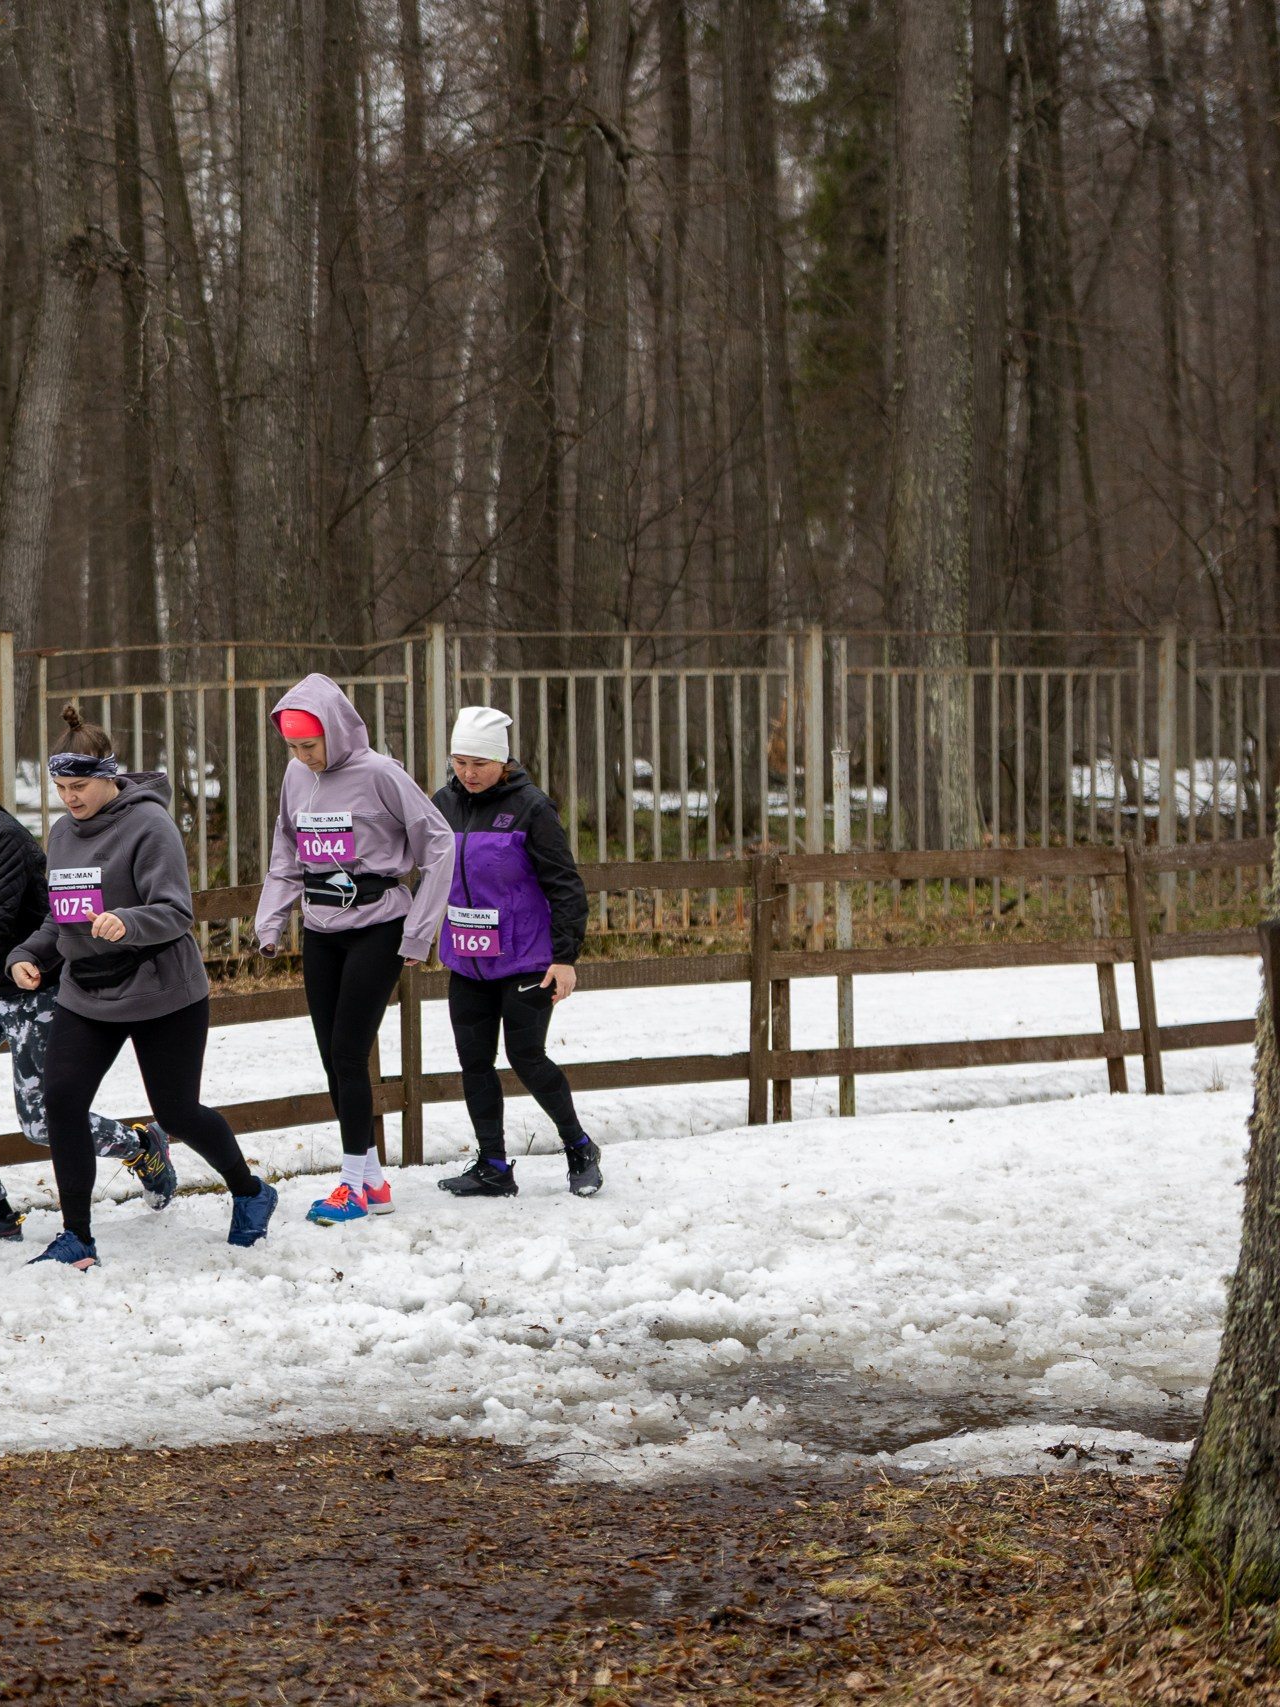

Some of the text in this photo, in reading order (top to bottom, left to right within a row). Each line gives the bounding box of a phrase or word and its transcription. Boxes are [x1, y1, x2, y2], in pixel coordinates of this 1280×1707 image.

[303, 840, 346, 856] 1044
[54, 897, 93, 916] 1075
[452, 933, 491, 951] 1169
